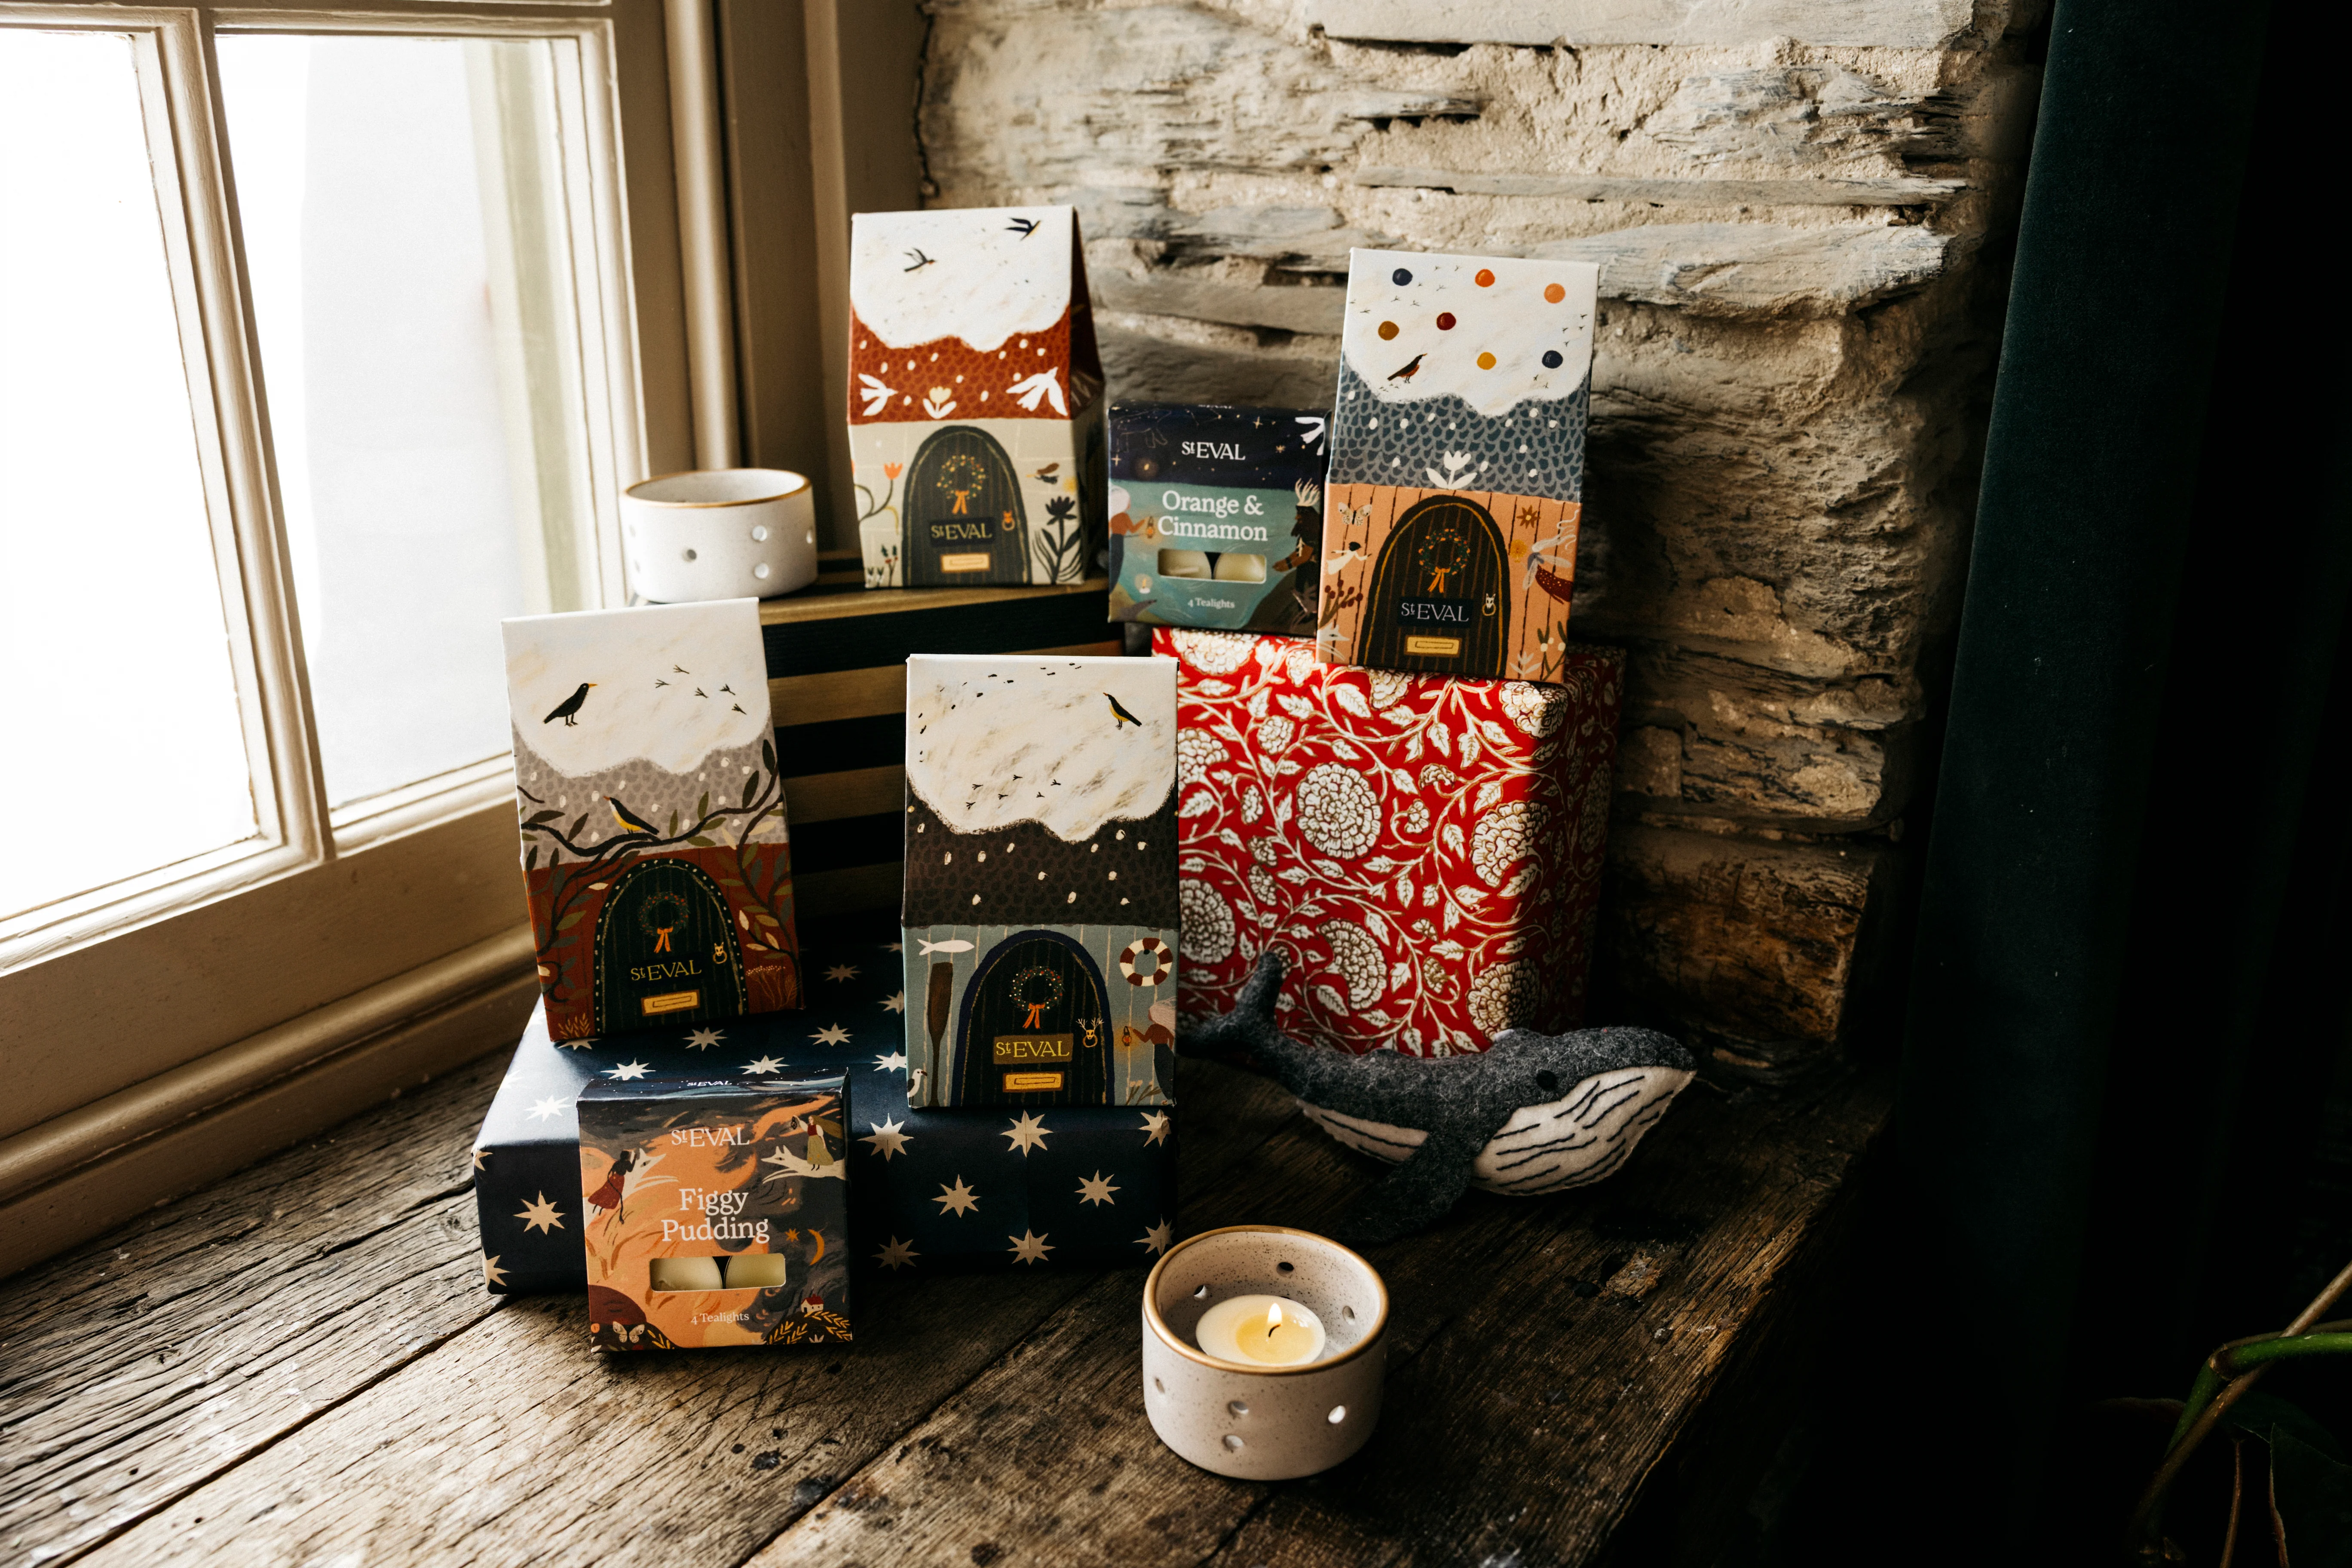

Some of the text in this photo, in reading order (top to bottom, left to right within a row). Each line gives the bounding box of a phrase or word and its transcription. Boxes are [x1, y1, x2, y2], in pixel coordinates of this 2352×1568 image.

[1162, 490, 1264, 518] Orange &
[1158, 516, 1268, 542] Cinnamon
[1194, 597, 1235, 609] Tealights
[679, 1188, 749, 1215] Figgy
[661, 1217, 770, 1243] Pudding
[691, 1312, 749, 1325] 4 Tealights
